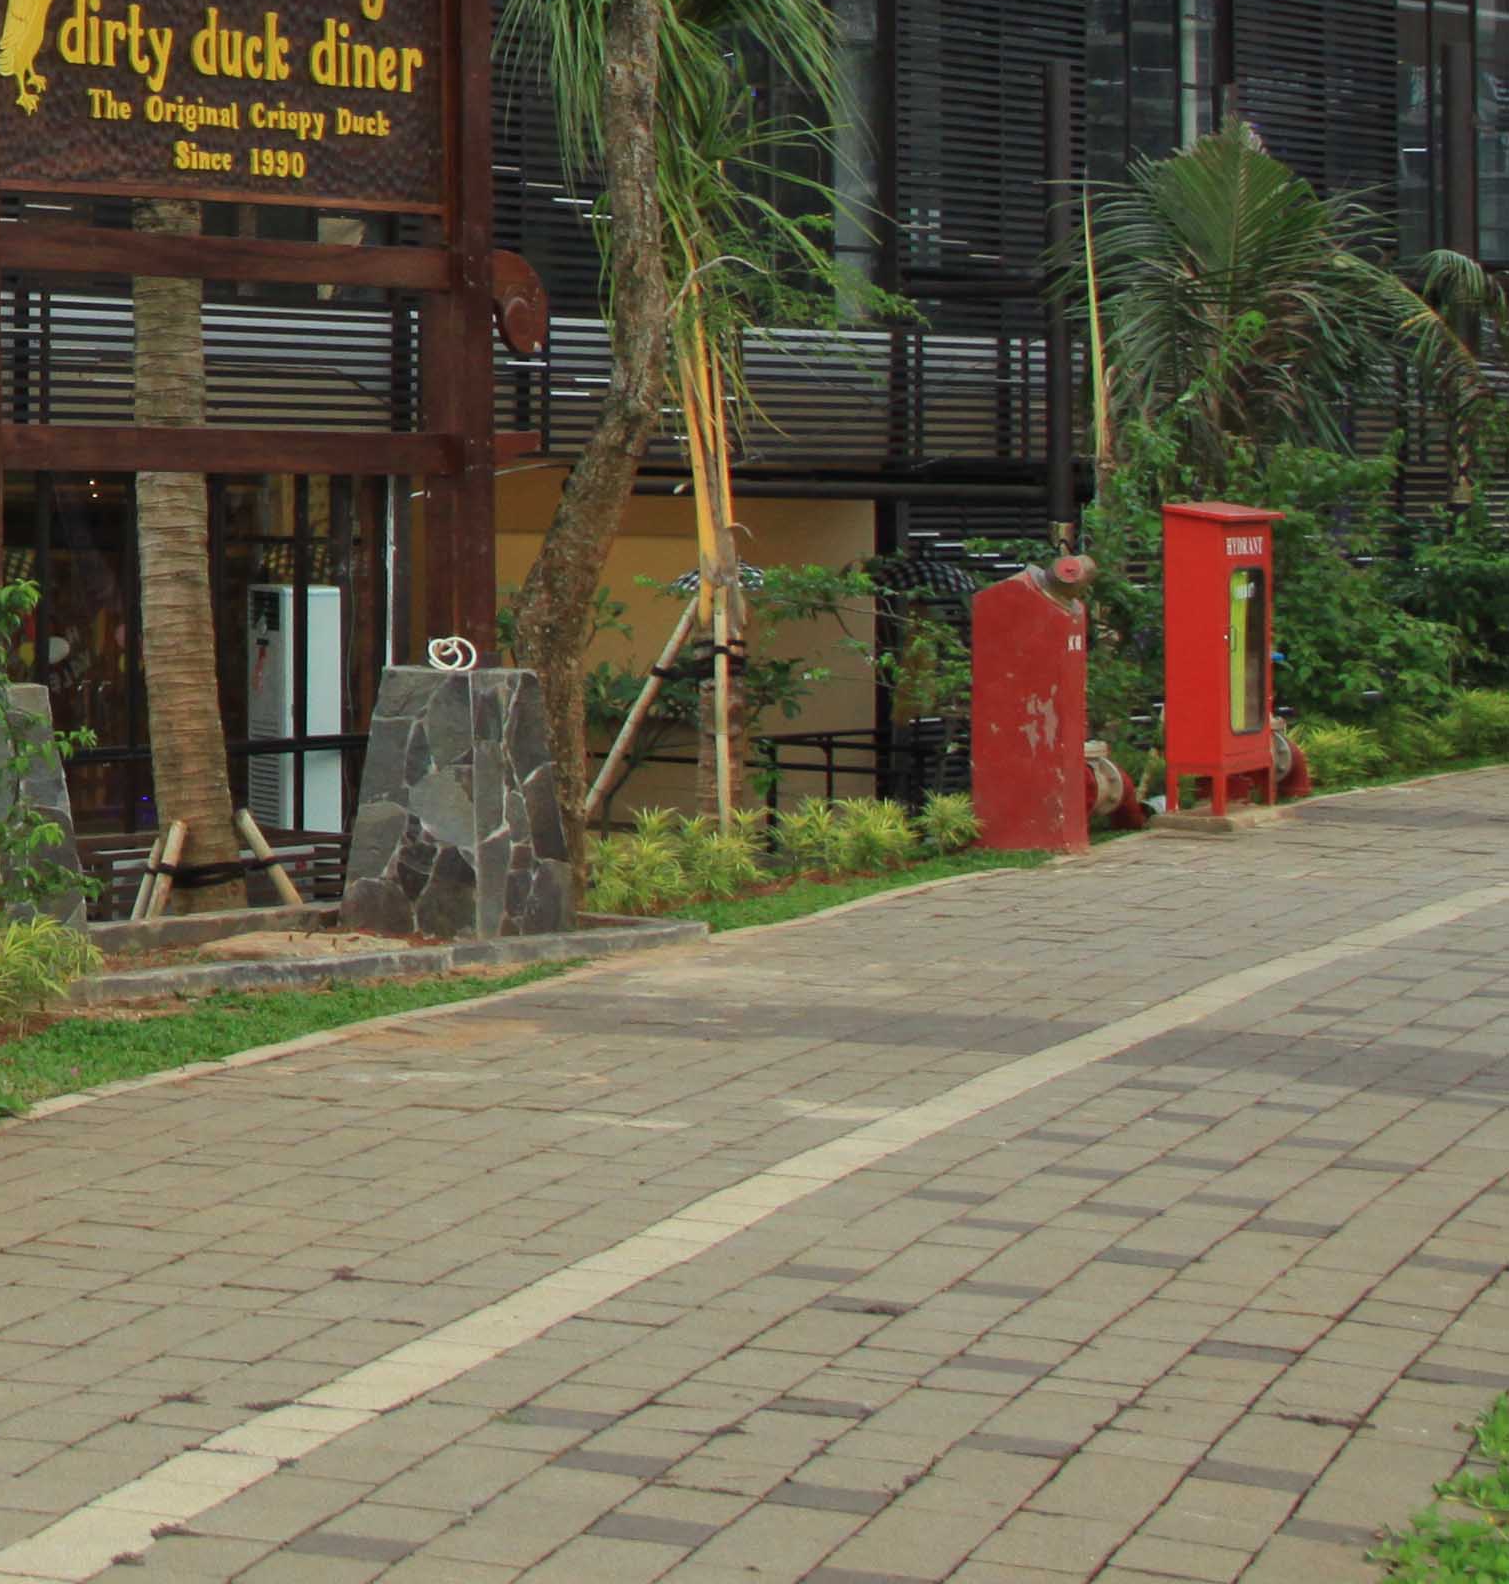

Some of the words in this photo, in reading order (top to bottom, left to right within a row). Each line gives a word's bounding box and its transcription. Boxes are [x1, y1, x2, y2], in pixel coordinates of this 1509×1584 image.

[192, 7, 291, 81] duck
[312, 18, 423, 92] diner
[88, 88, 132, 120] The
[145, 95, 239, 132] Original
[250, 101, 326, 140] Crispy
[337, 107, 391, 136] Duck
[175, 140, 232, 171] Since
[251, 148, 306, 178] 1990
[1225, 536, 1263, 555] HYDRANT
